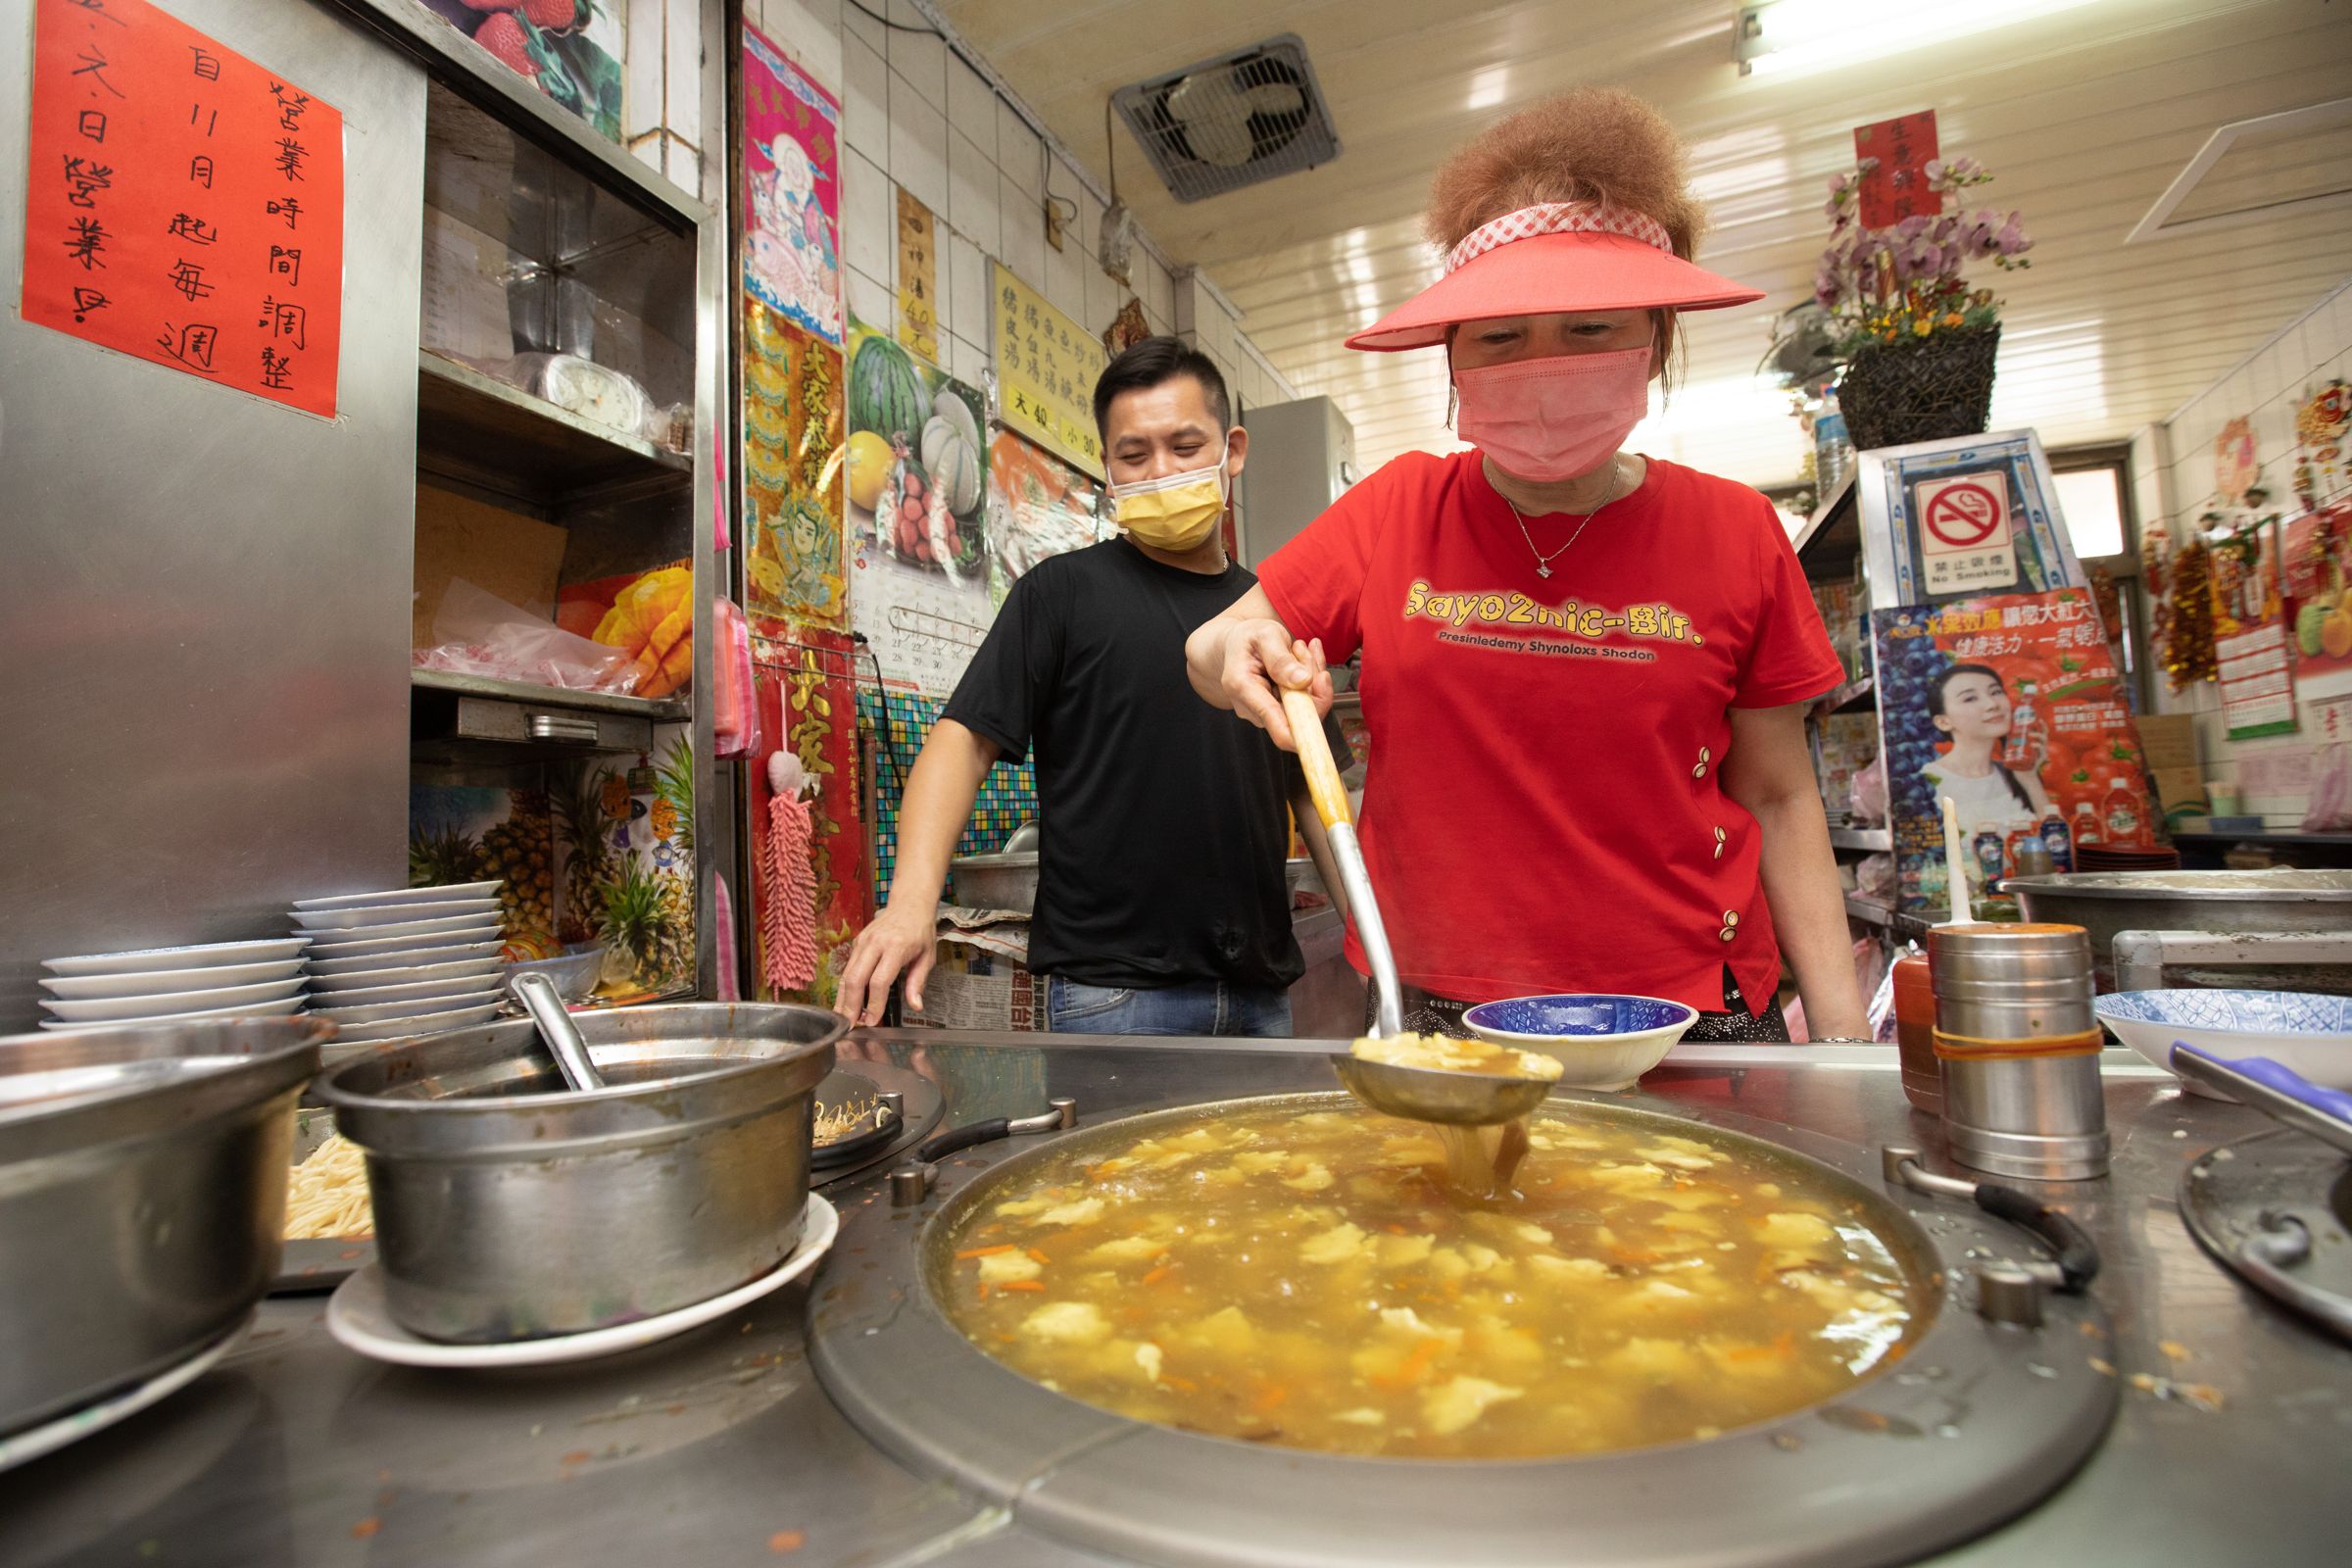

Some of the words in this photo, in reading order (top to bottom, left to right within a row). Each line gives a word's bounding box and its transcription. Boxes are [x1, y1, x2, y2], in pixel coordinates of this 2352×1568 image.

[259, 80, 310, 391] 營業時間調整
[1015, 392, 1027, 416] 大
[1034, 405, 1047, 426] 40
[1067, 427, 1077, 444] 小
[1083, 435, 1095, 456] 30
[1935, 555, 2004, 572] 禁止吸煙
[1932, 573, 1948, 583] No
[1957, 568, 2010, 581] Smoking
[1601, 649, 1655, 661] Shodon
